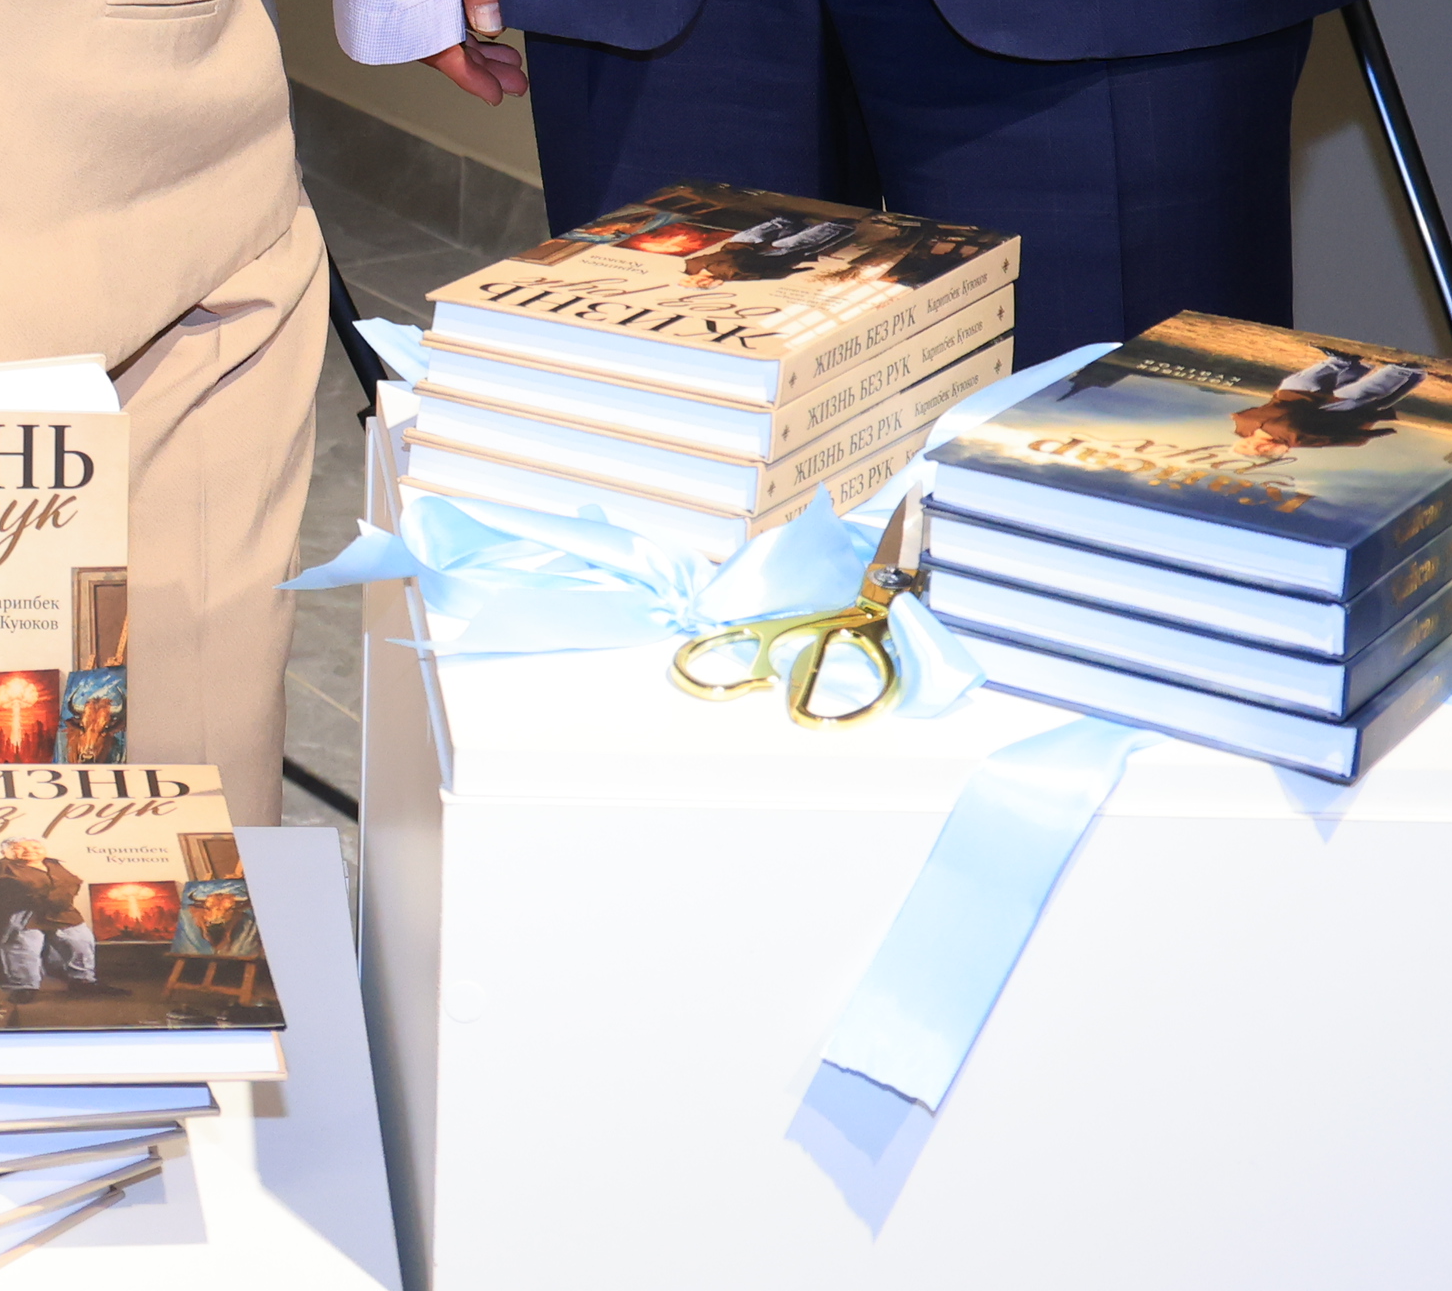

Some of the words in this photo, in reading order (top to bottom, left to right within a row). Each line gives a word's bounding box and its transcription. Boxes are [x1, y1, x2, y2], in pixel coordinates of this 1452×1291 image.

[479, 282, 785, 350] ЖИЗНЬ
[813, 336, 861, 379] ЖИЗНЬ
[866, 317, 889, 350] БЕЗ
[891, 304, 917, 336] РУК
[807, 387, 855, 430] ЖИЗНЬ
[860, 368, 883, 401] БЕЗ
[886, 354, 911, 386] РУК
[794, 441, 844, 486] ЖИЗНЬ
[849, 421, 873, 455] БЕЗ
[877, 409, 903, 440] РУК
[840, 472, 864, 504] БЕЗ
[868, 456, 894, 489] РУК
[0, 615, 59, 633] Куюков
[42, 798, 177, 839] рук
[86, 846, 169, 855] Карипбек
